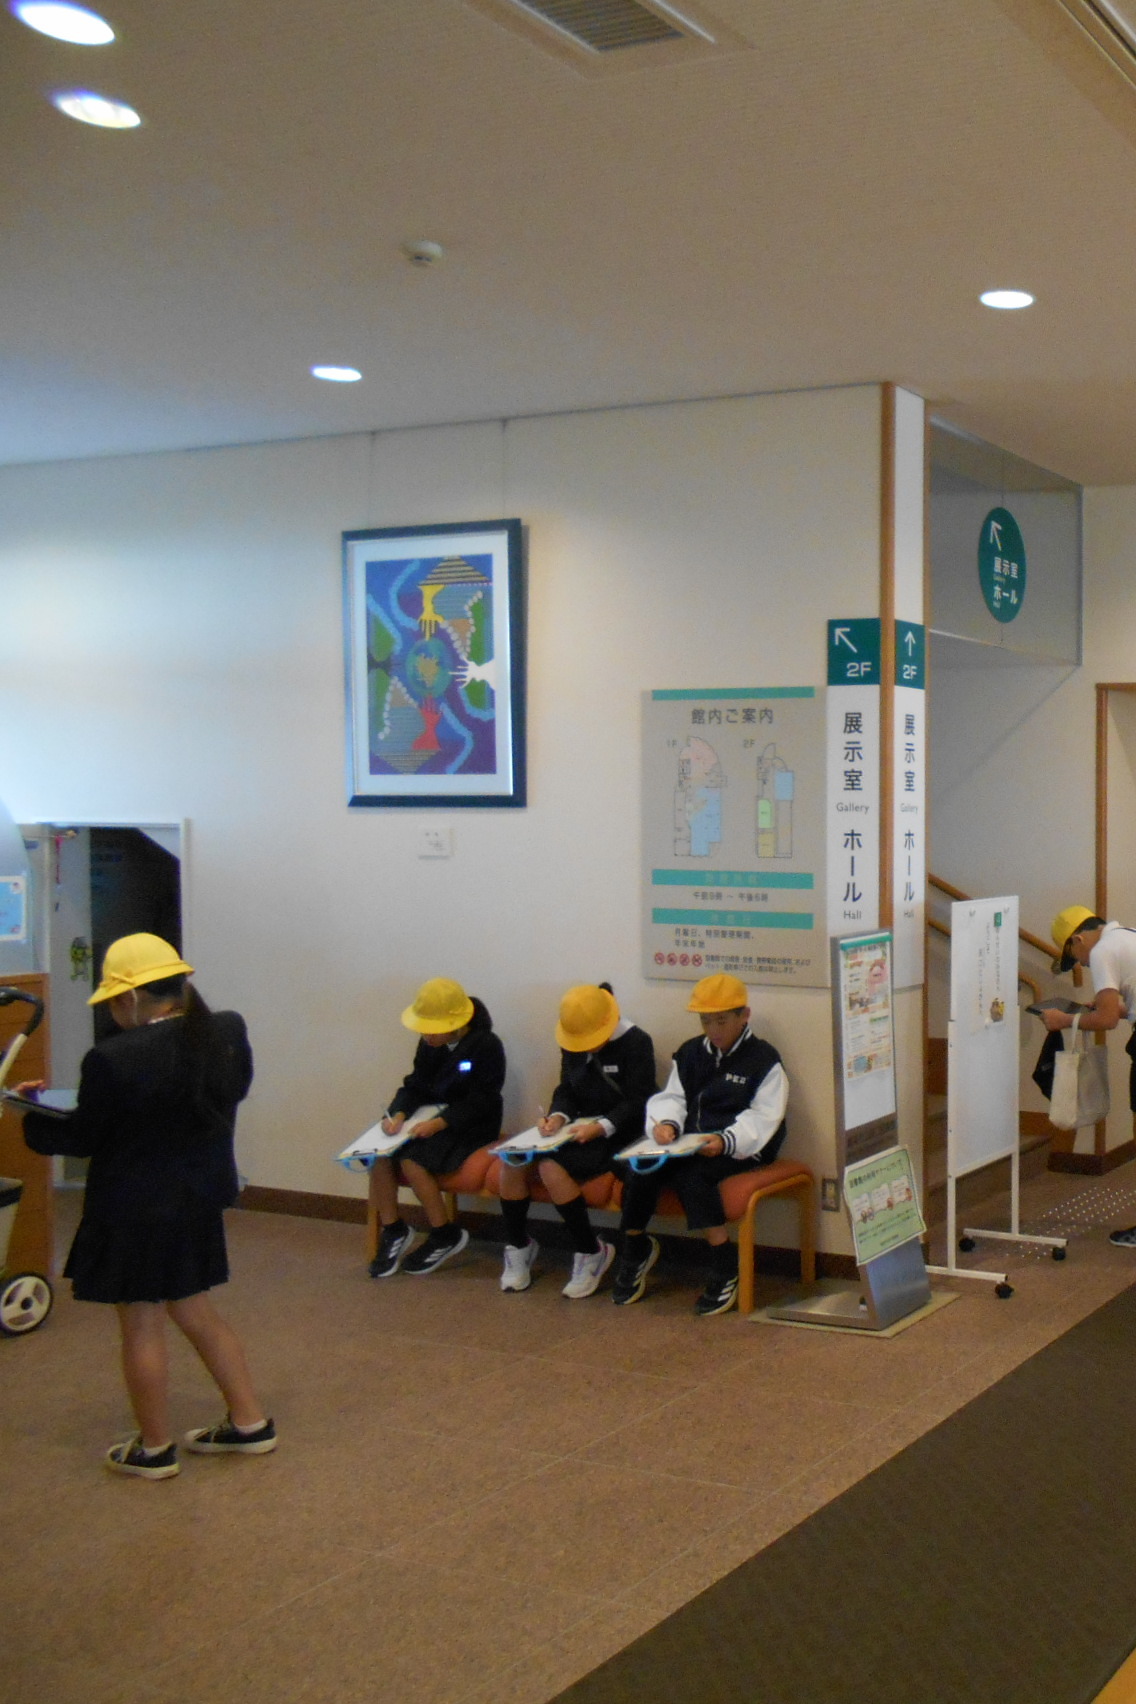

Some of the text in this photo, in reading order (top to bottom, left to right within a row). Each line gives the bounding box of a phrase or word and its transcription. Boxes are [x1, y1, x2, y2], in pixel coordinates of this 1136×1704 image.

[846, 662, 872, 677] 2F
[903, 664, 918, 680] 2F
[691, 708, 774, 725] 館内ご案内
[843, 712, 863, 791] 展示室
[904, 714, 915, 792] 展示室
[836, 802, 870, 815] Gallery
[843, 829, 863, 903] ホール
[904, 829, 915, 902] ホール
[843, 910, 862, 920] Hall
